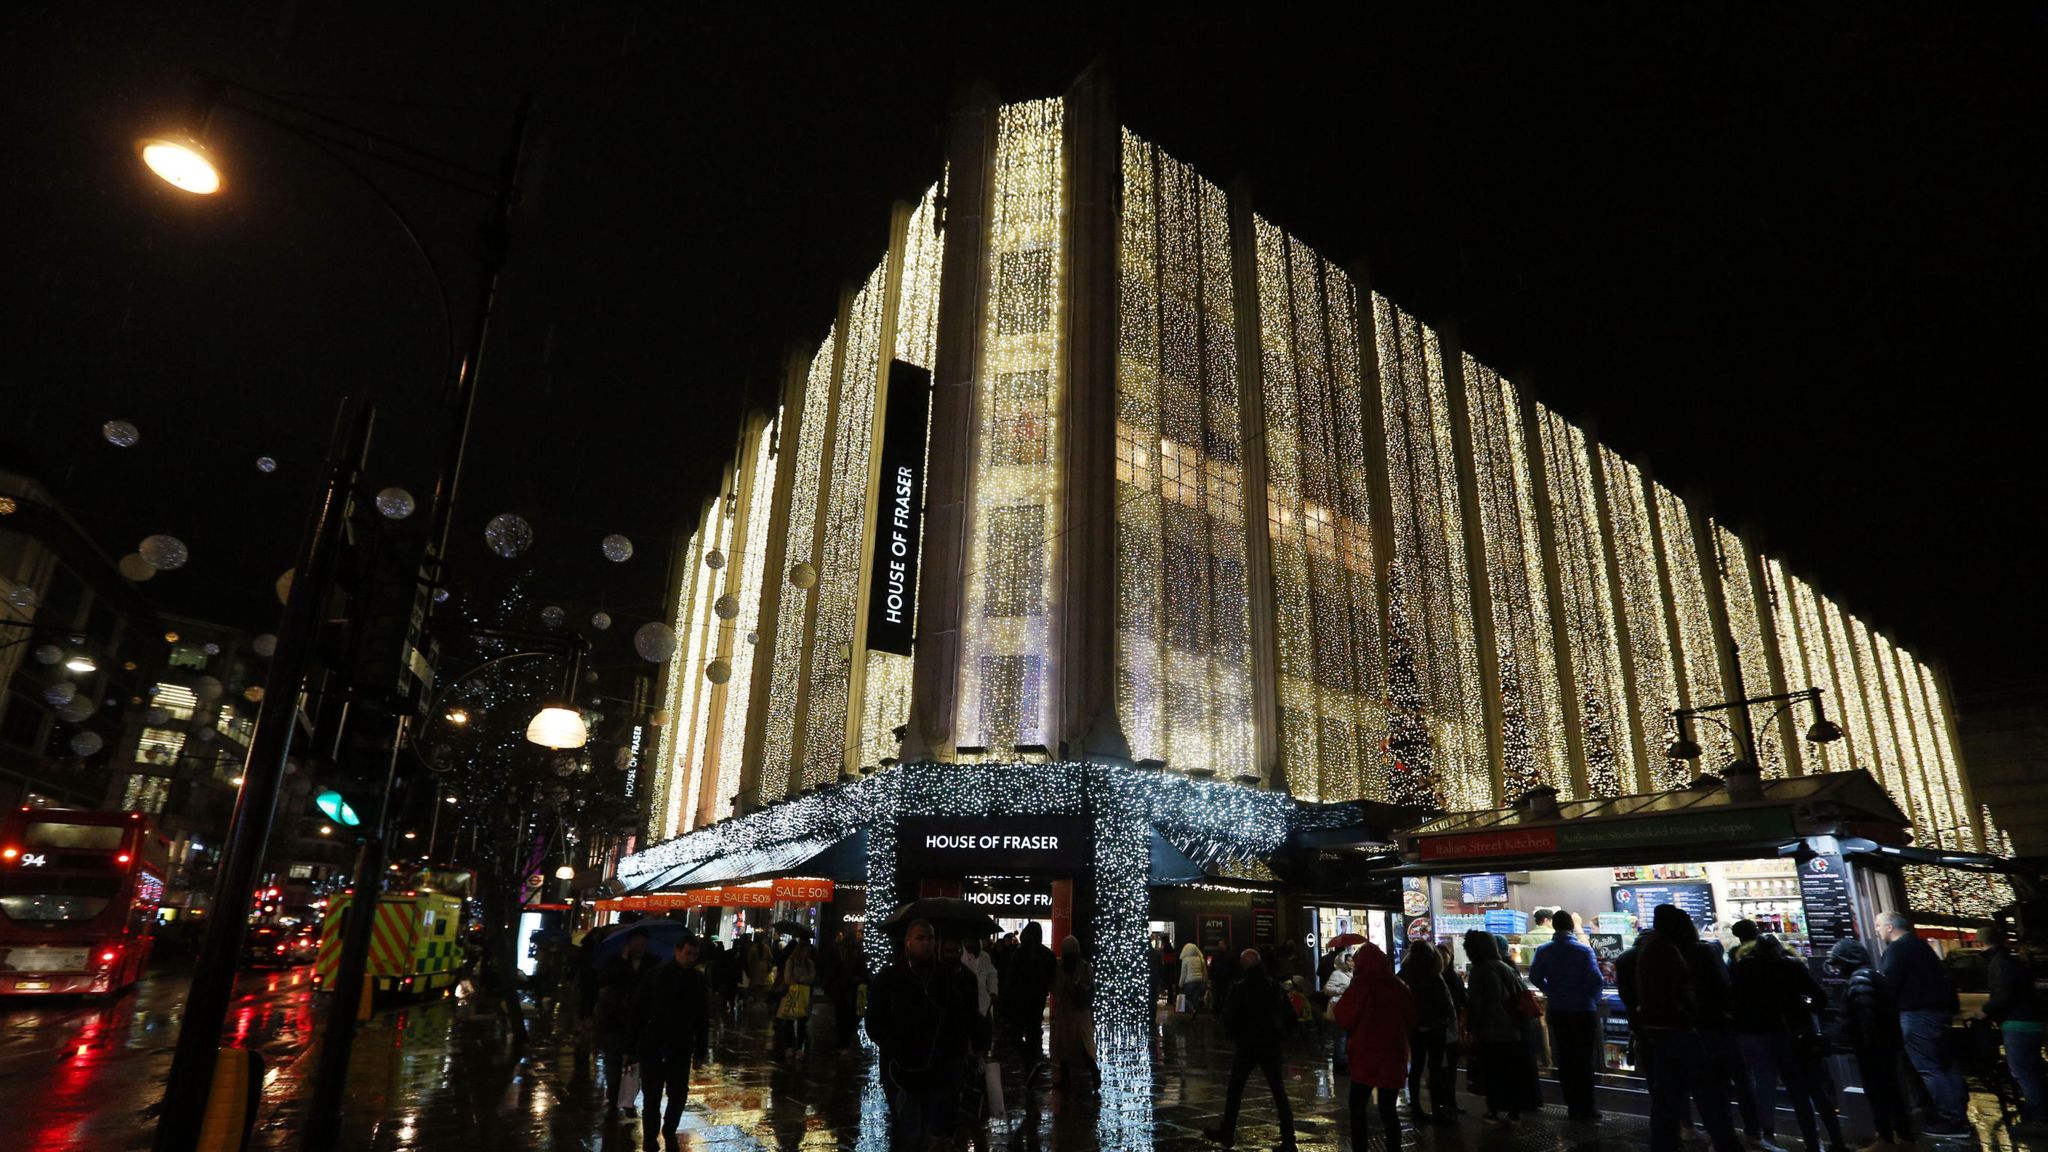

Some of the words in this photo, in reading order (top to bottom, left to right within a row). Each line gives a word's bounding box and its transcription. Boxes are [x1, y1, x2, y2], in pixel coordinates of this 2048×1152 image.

[894, 466, 912, 528] FRASER
[891, 530, 907, 556] OF
[886, 560, 905, 623] HOUSE
[624, 769, 637, 797] HOUSE
[631, 725, 642, 755] FRASER
[926, 835, 976, 849] HOUSE
[979, 835, 1000, 849] OF
[1003, 836, 1058, 849] FRASER
[1434, 840, 1467, 855] Italian
[1469, 840, 1501, 852] Street
[1505, 834, 1550, 850] Kitchen
[20, 853, 46, 867] 94
[688, 894, 711, 904] SALE
[723, 892, 750, 903] SALE
[776, 886, 806, 898] SALE
[808, 887, 829, 898] 50%
[968, 892, 1006, 905] HOUSE
[1013, 893, 1031, 905] OF
[648, 899, 669, 907] SALE
[1205, 920, 1223, 928] ATM
